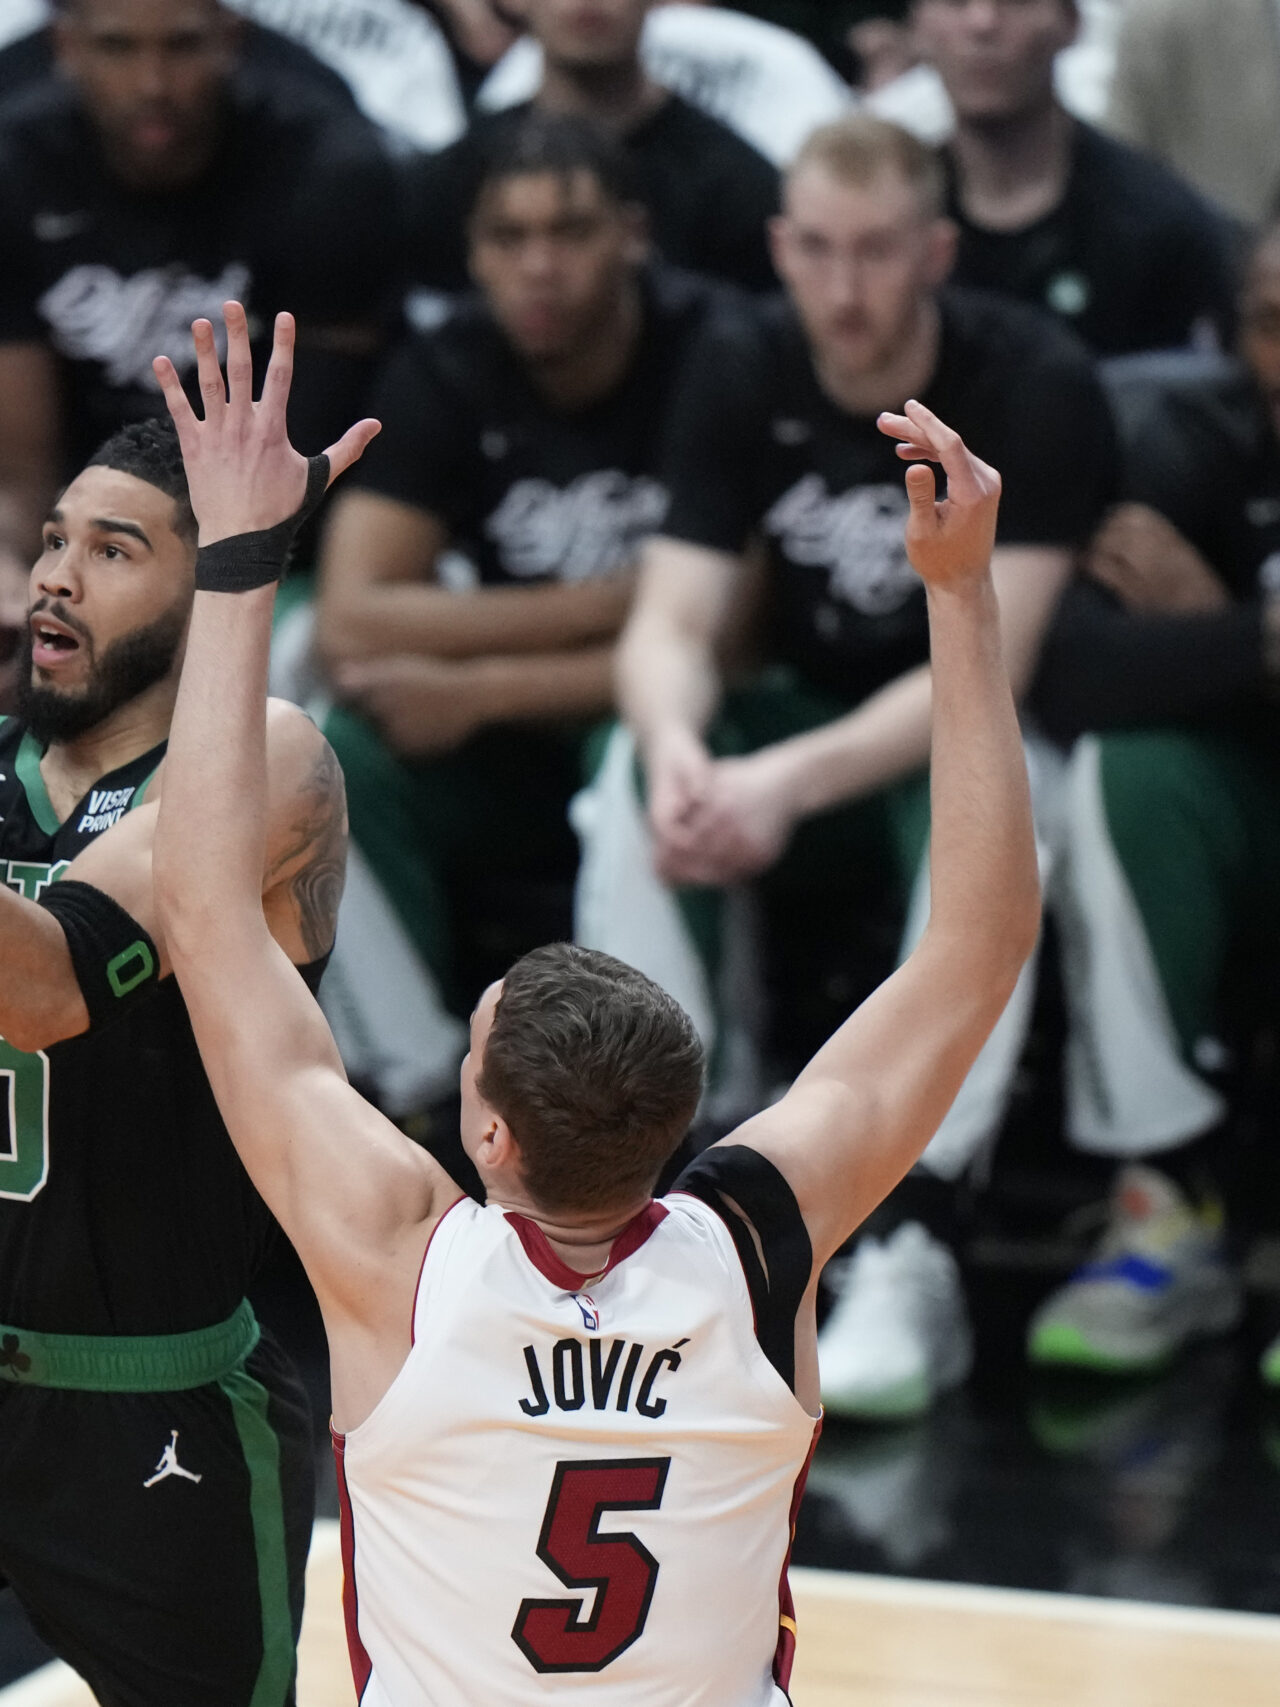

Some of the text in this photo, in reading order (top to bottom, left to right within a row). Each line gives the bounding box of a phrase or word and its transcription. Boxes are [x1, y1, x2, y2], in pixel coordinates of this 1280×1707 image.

[77, 807, 125, 833] PRINT
[87, 786, 136, 815] VISTA
[518, 1337, 692, 1420] JOVIĆ
[511, 1456, 671, 1674] 5
